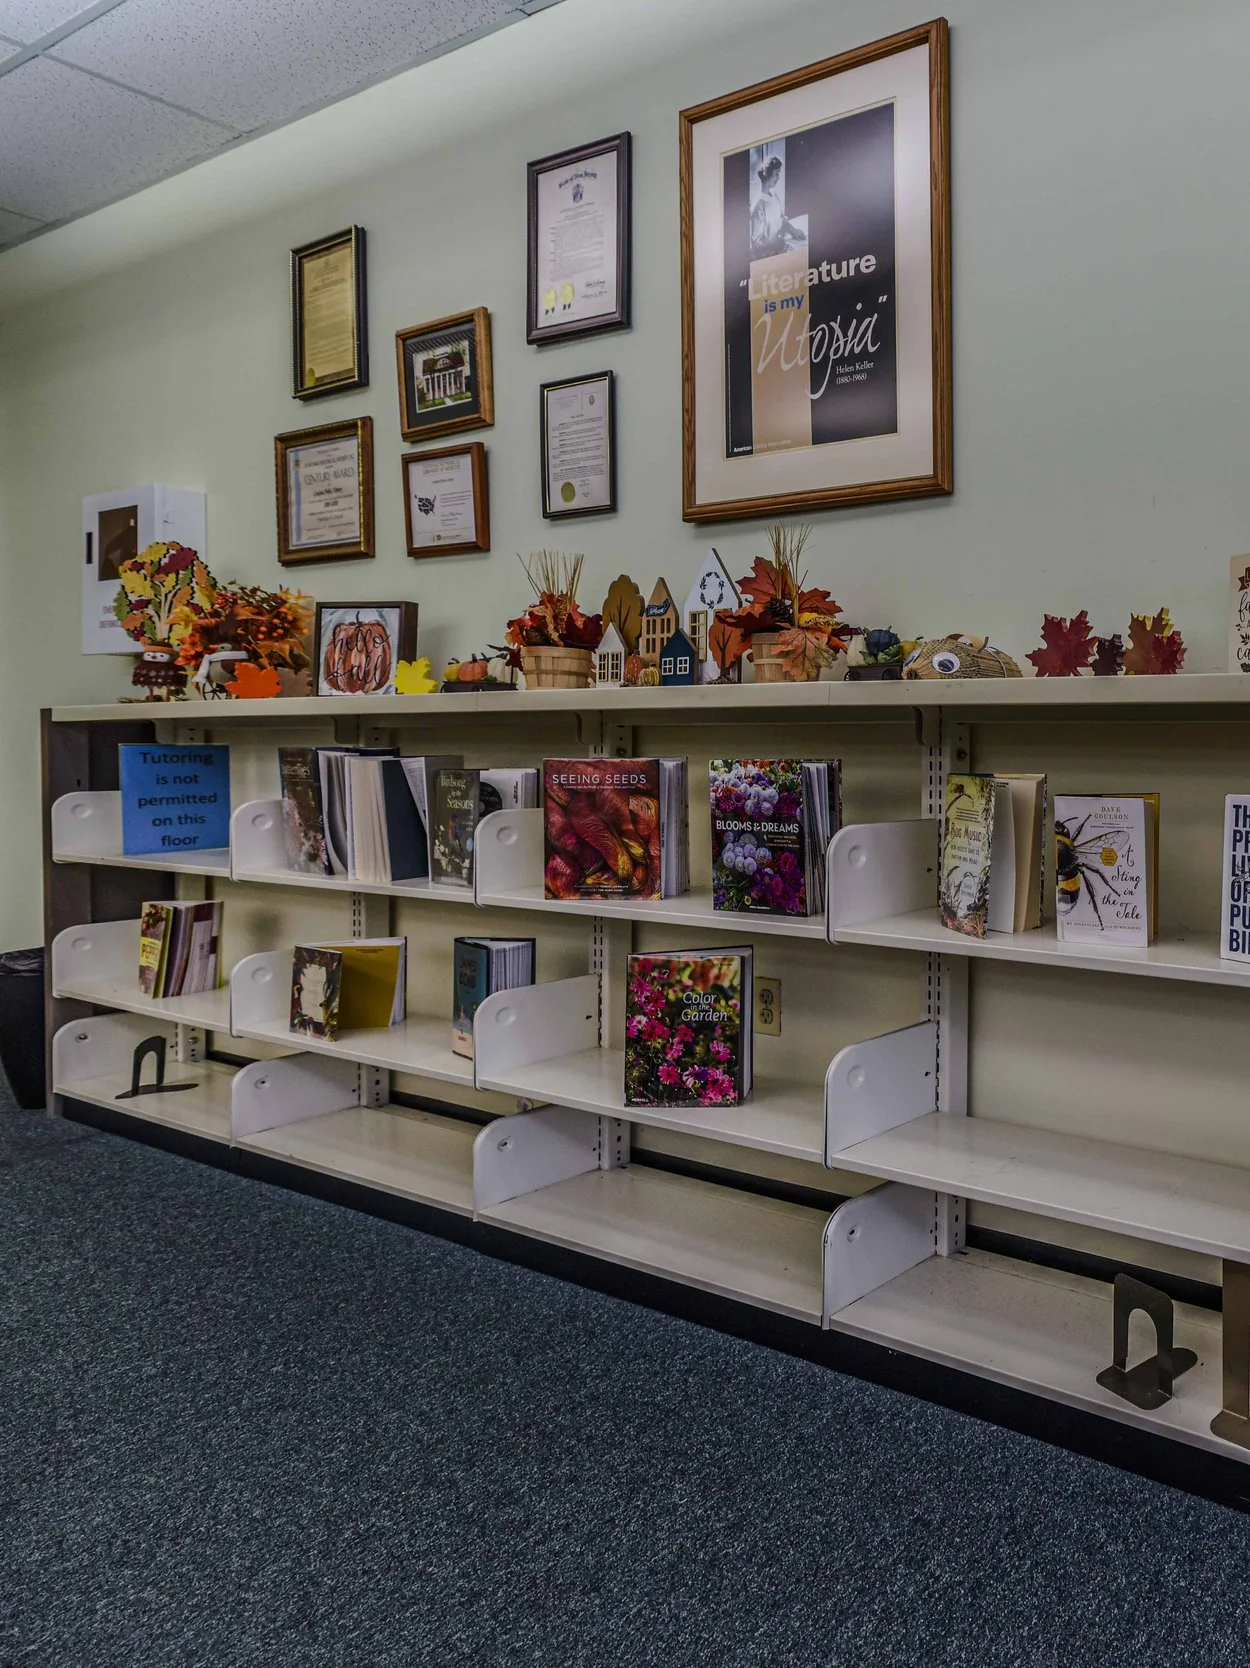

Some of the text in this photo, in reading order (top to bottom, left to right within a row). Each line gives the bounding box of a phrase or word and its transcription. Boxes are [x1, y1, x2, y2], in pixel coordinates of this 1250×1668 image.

[764, 294, 804, 314] is my
[836, 360, 874, 375] Helen Keller
[836, 372, 867, 385] (1880-1968)
[327, 623, 391, 657] hello
[327, 655, 391, 692] fall
[140, 752, 214, 766] Tutoring
[156, 774, 200, 784] is not
[552, 775, 646, 783] SEEING SEEDS
[138, 793, 217, 808] permitted
[447, 795, 474, 809] Seasons
[152, 813, 206, 826] on this
[716, 820, 799, 833] BLOOMS & DREAMS
[161, 835, 200, 846] floor
[1122, 843, 1134, 867] A
[1111, 865, 1142, 889] Sting
[1124, 887, 1135, 896] in
[1231, 880, 1250, 904] OF
[1101, 896, 1118, 906] the
[1116, 902, 1142, 920] Tale
[683, 992, 717, 1004] Color
[681, 1009, 728, 1022] Garden
